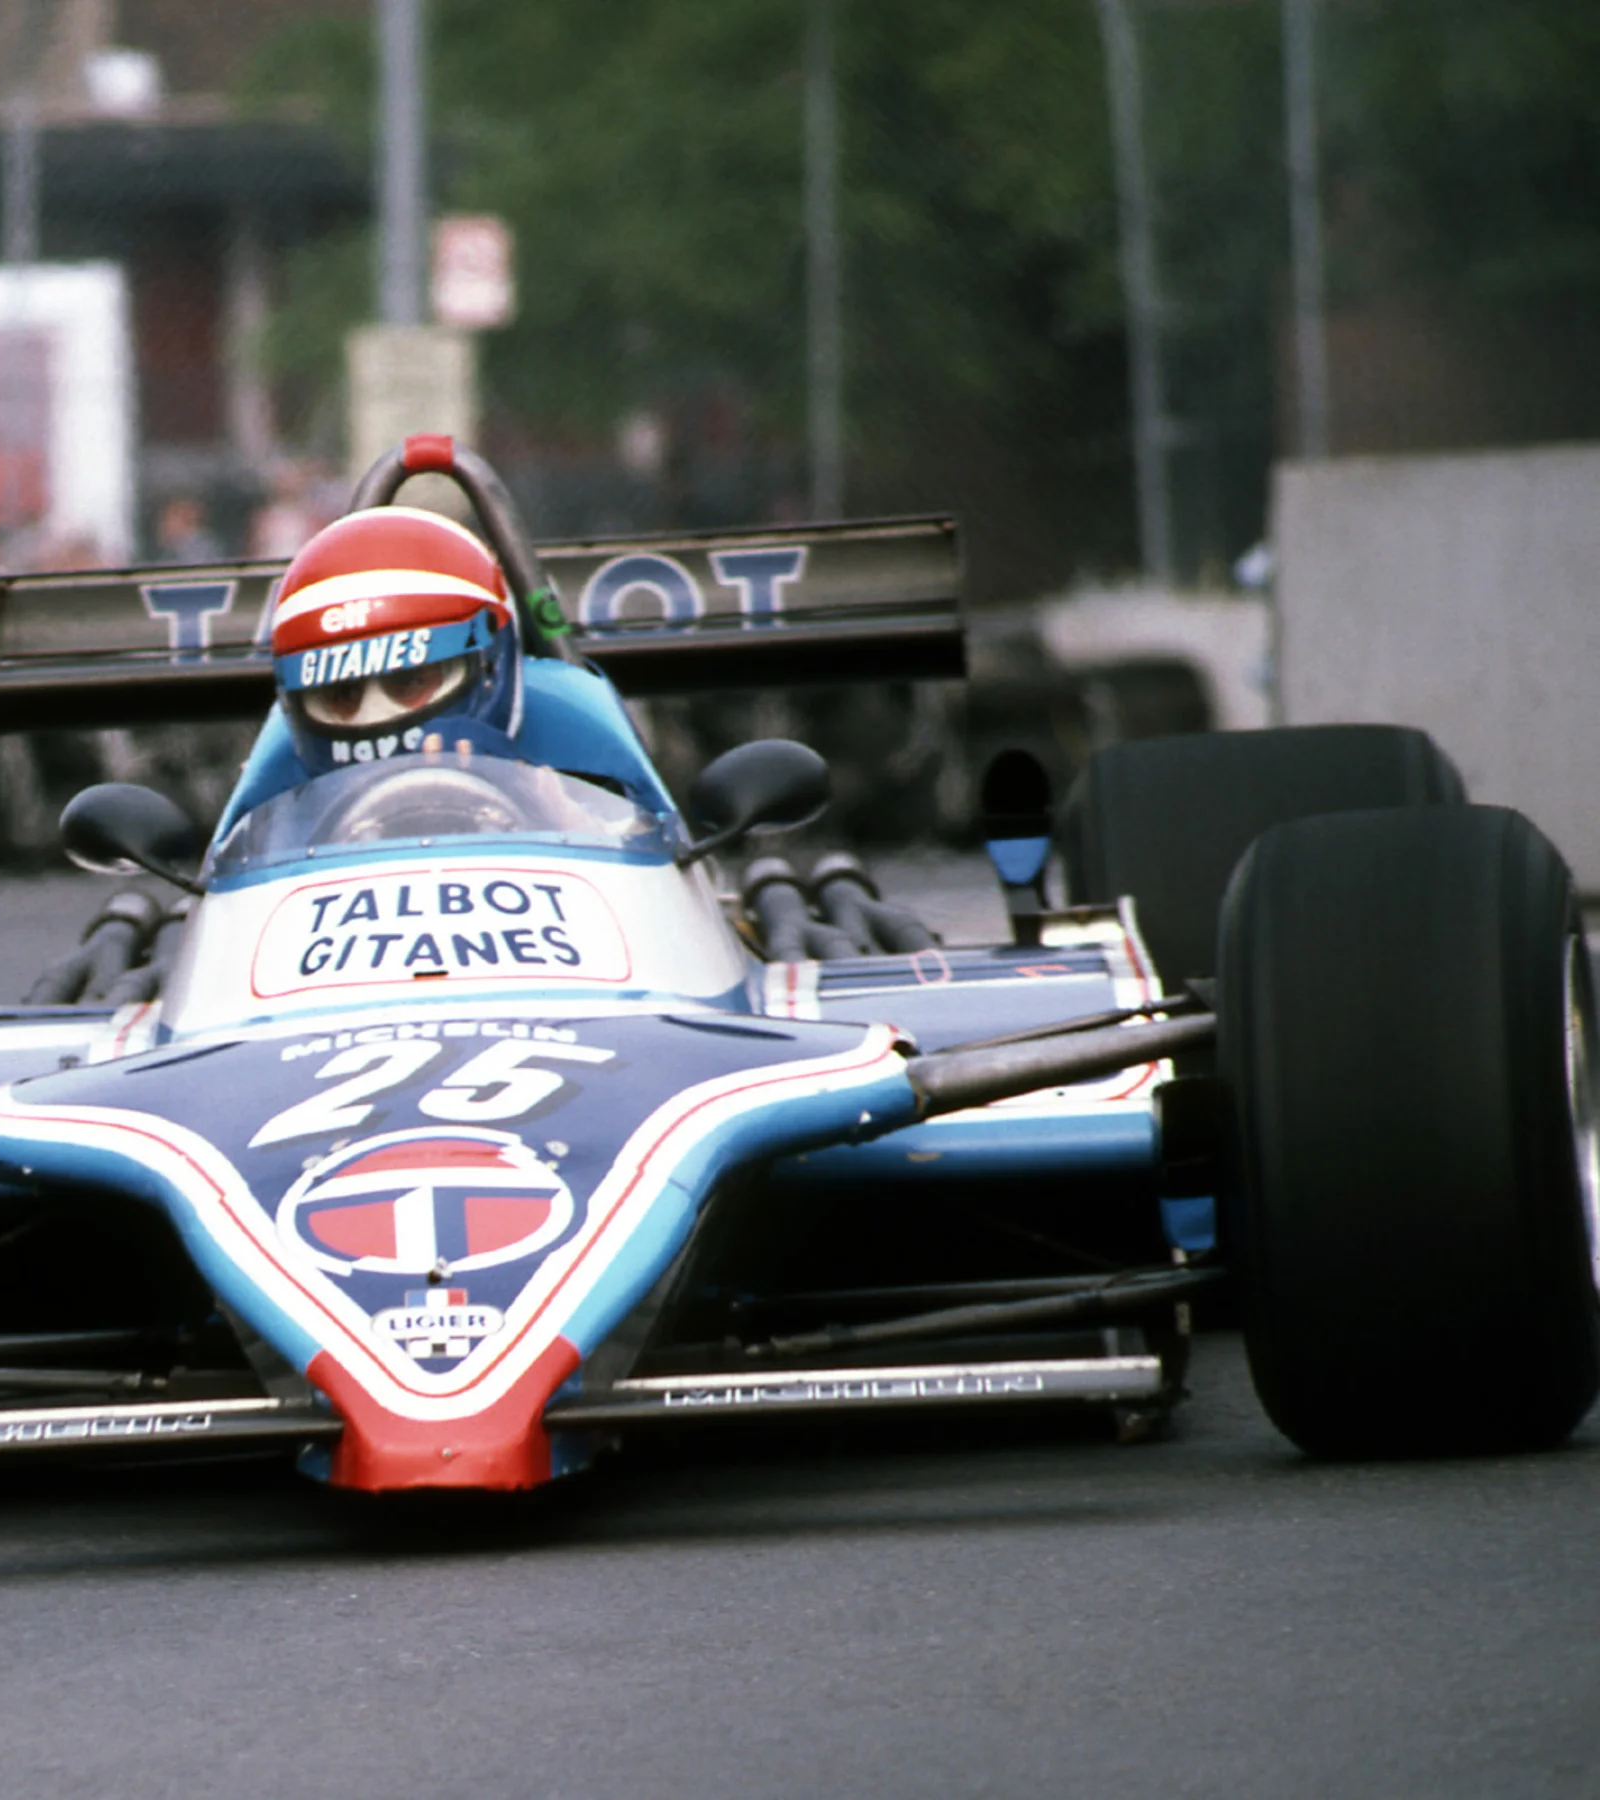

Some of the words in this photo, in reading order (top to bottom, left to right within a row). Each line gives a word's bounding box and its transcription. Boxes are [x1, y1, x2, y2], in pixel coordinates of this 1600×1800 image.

[140, 546, 808, 664] TOT
[320, 599, 370, 633] elf
[300, 627, 431, 687] GITANES
[311, 880, 566, 934] TALBOT
[300, 926, 581, 976] GITANES
[281, 1021, 578, 1062] MICHELIN
[247, 1039, 616, 1149] 25
[389, 1314, 486, 1331] LIGIER
